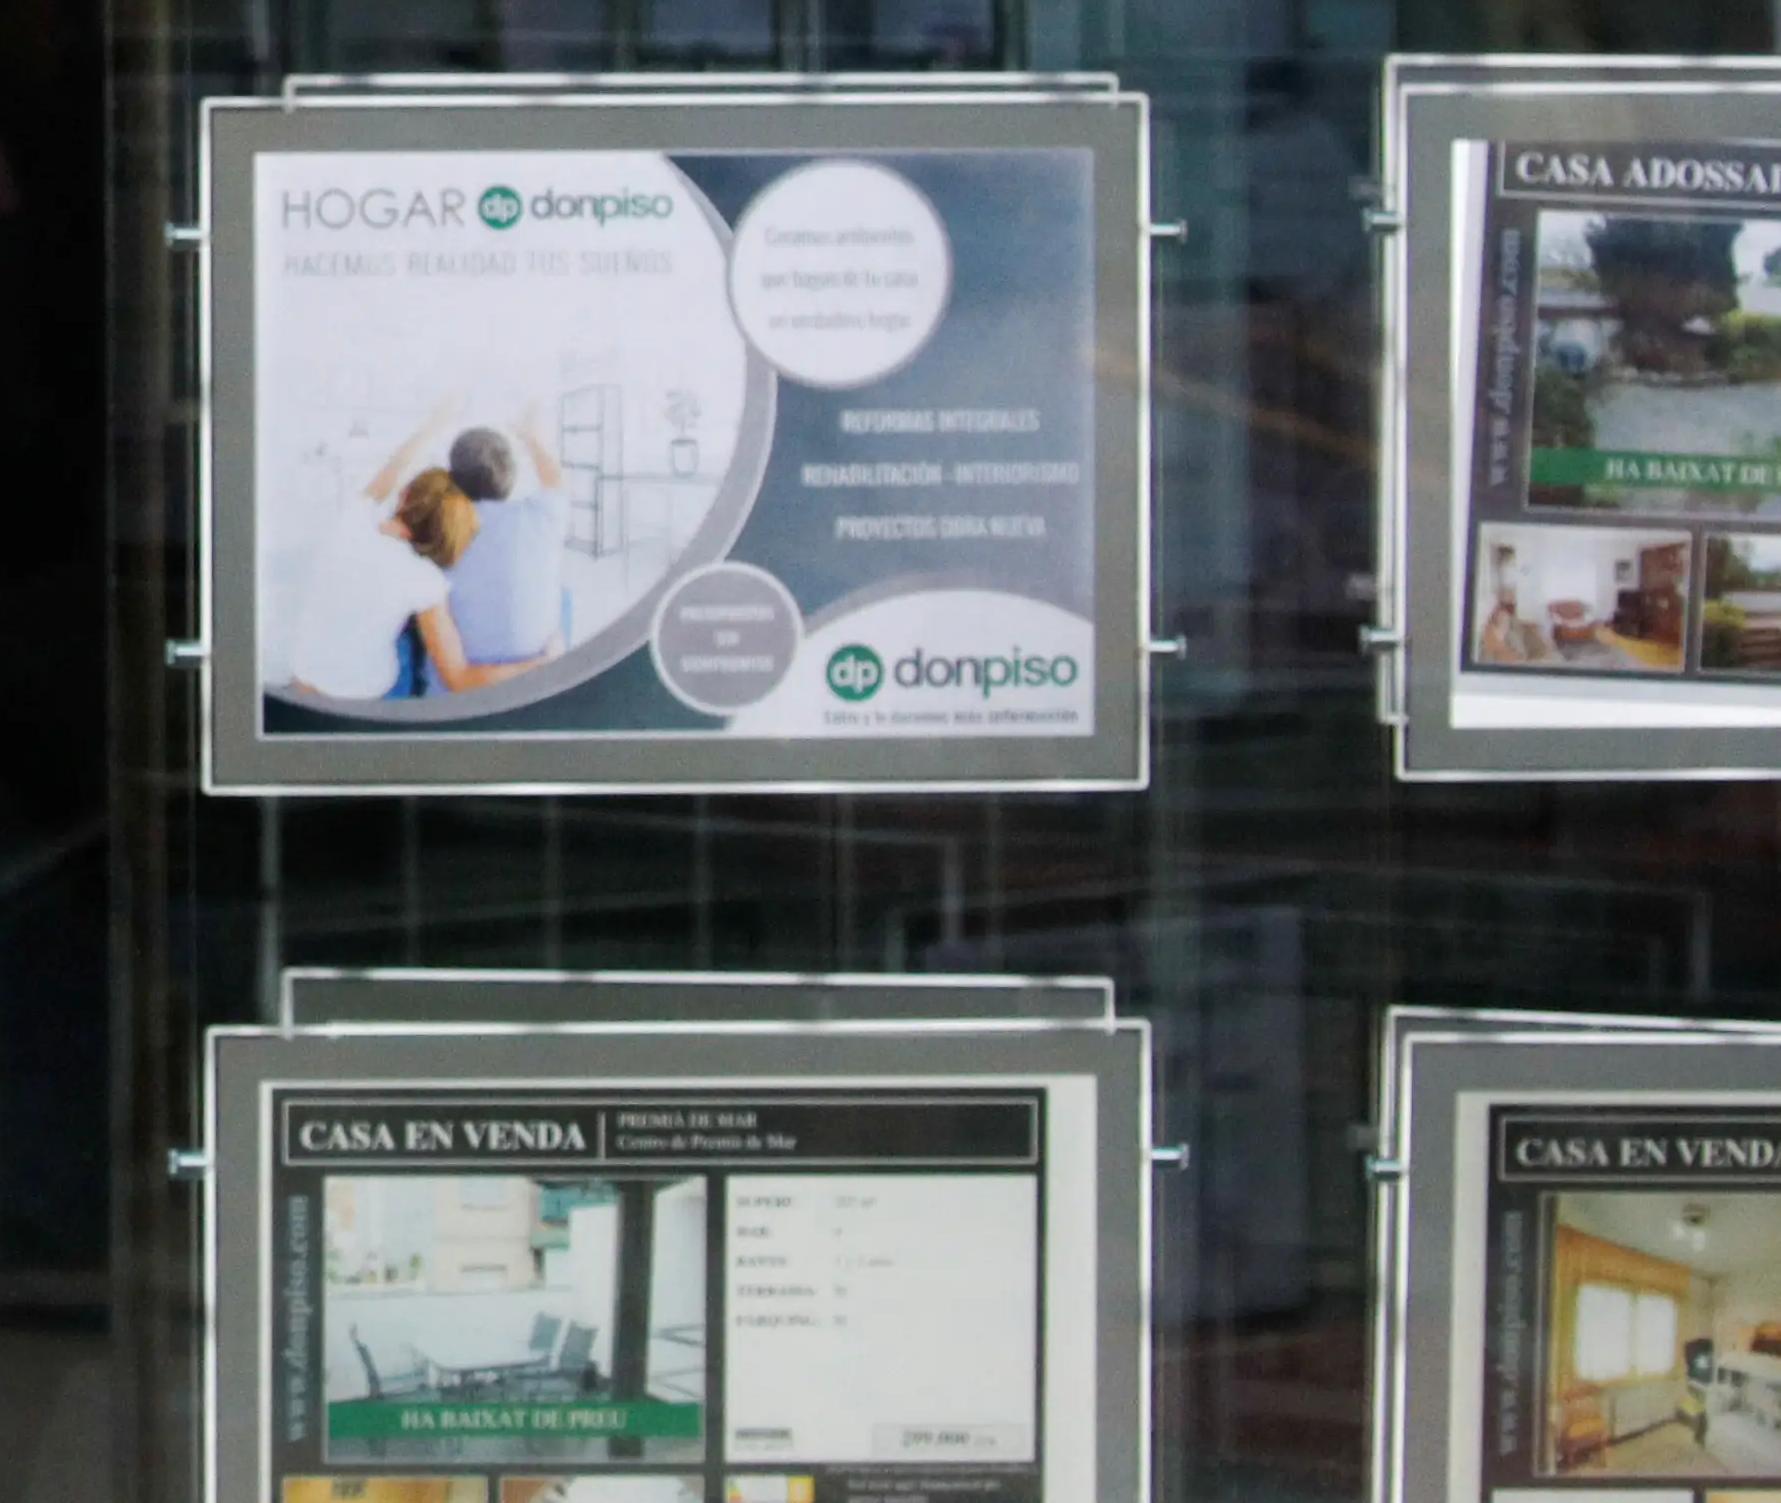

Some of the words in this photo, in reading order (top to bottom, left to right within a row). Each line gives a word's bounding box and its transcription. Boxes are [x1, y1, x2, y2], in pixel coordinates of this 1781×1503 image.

[1514, 153, 1614, 186] CASA
[281, 187, 467, 231] HOGAR
[529, 188, 674, 227] donpiso
[1647, 460, 1732, 484] BAIXAT
[893, 646, 1079, 700] donpiso
[299, 1122, 395, 1151] CASA
[405, 1121, 453, 1150] EN
[463, 1121, 586, 1150] VENDA
[1516, 1139, 1609, 1166] CASA
[1620, 1138, 1667, 1167] EN
[1677, 1138, 1781, 1168] VEND
[401, 1410, 435, 1429] HA
[439, 1408, 527, 1429] BAIXAT
[531, 1408, 563, 1429] DE
[566, 1408, 624, 1429] PREU
